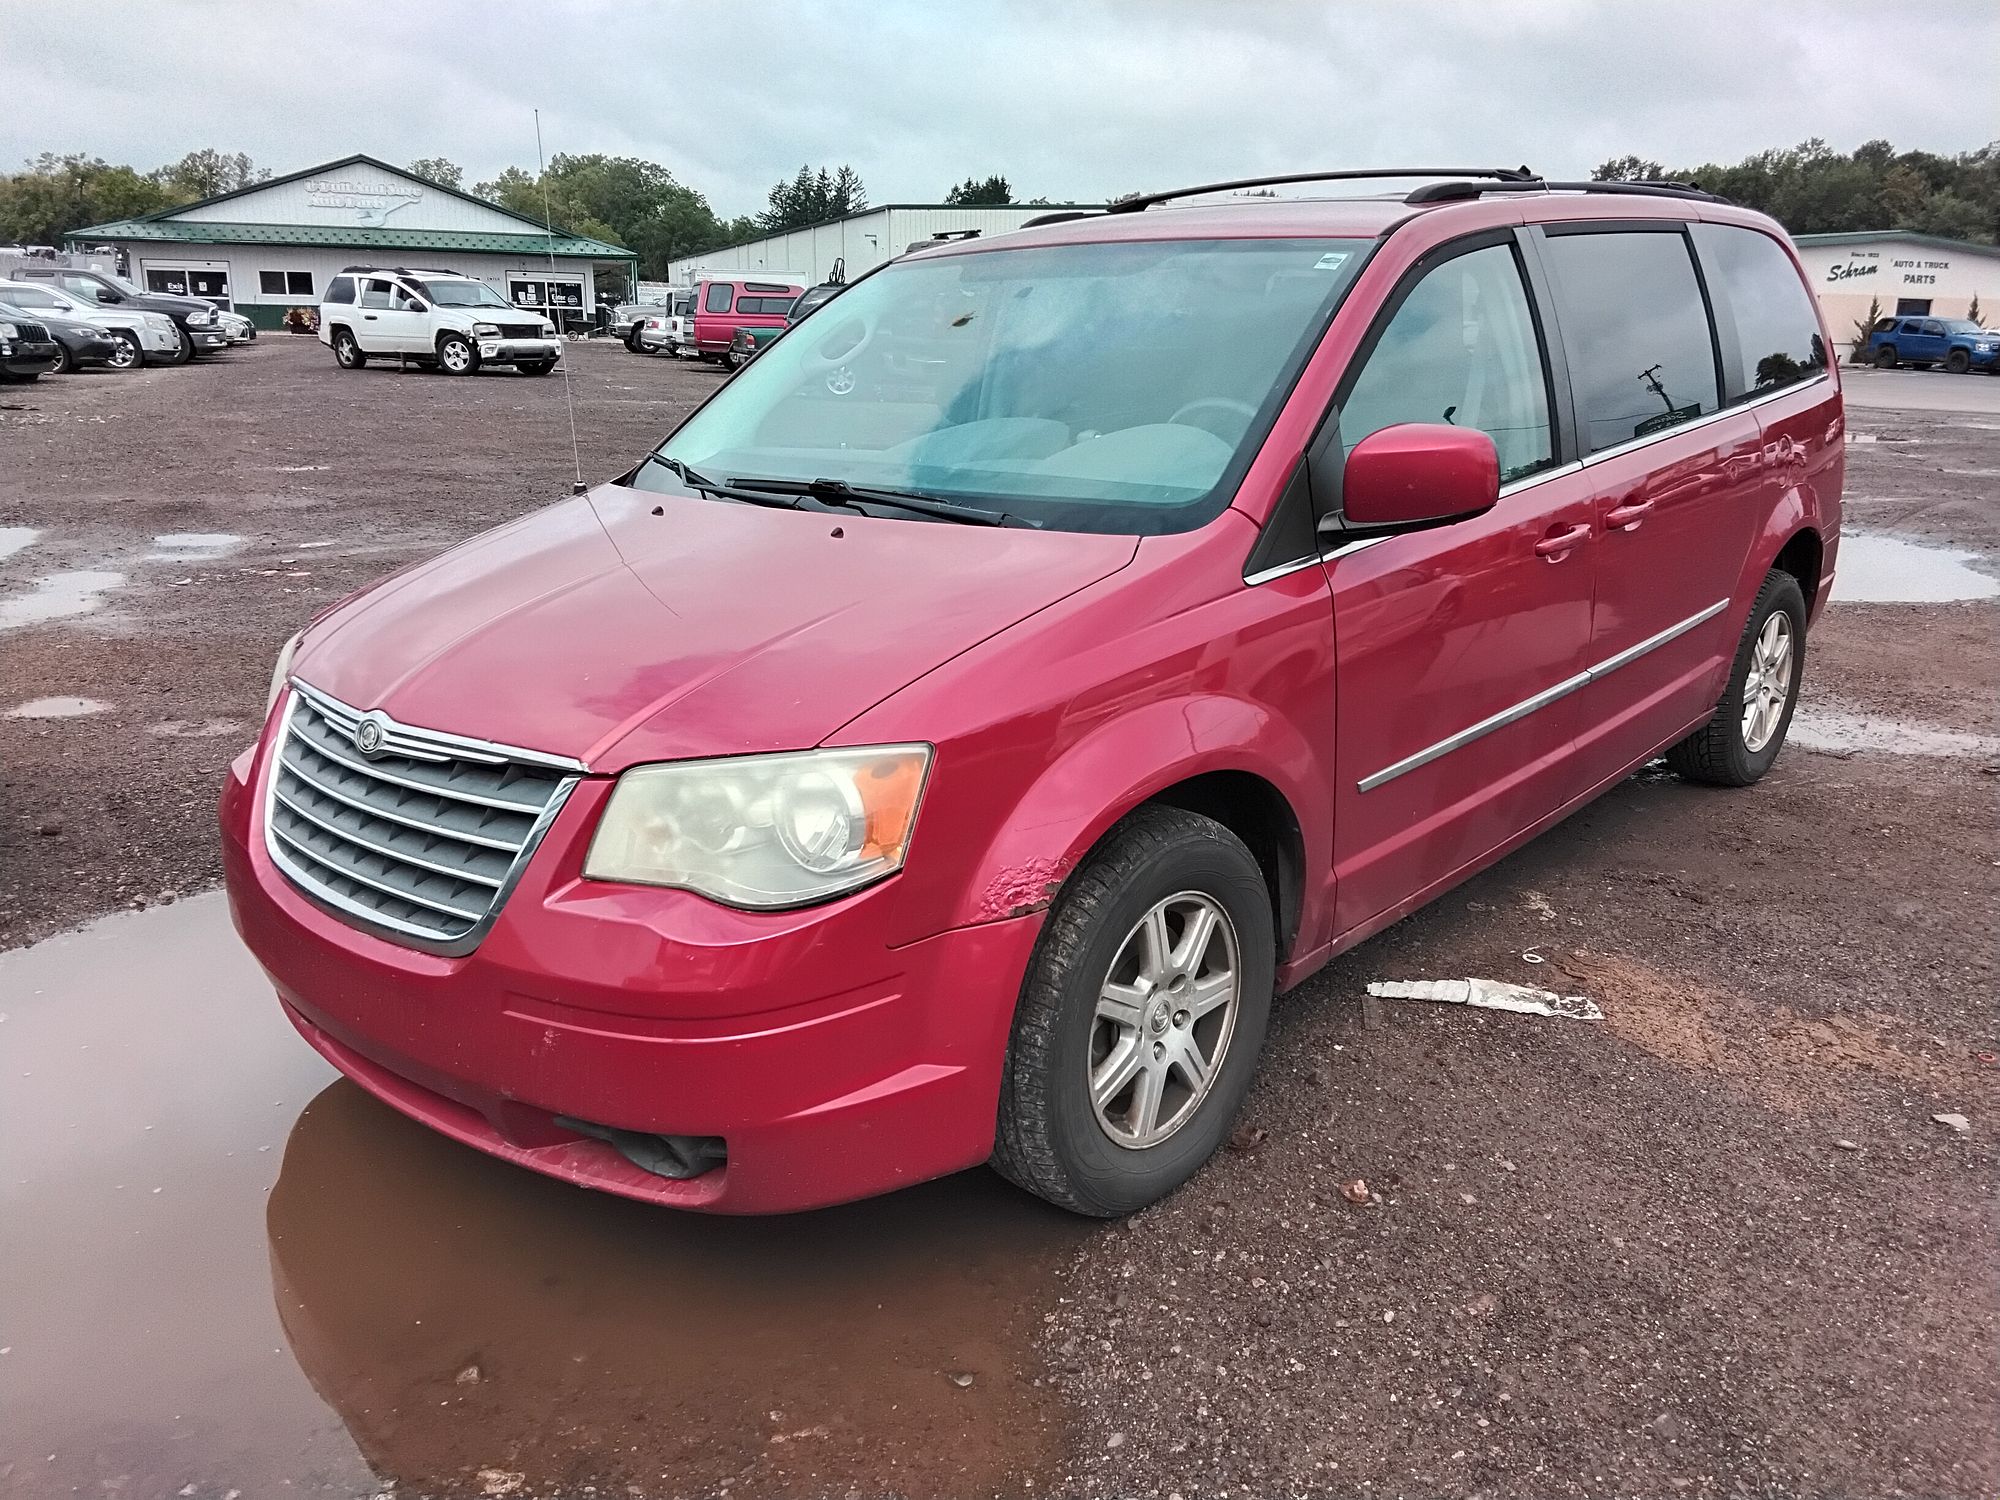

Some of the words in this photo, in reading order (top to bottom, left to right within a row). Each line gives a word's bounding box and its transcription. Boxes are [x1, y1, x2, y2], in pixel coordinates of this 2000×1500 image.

[1893, 260, 1914, 268] AUTO
[1924, 261, 1950, 269] TRUCK
[1827, 261, 1879, 282] Schram
[1903, 274, 1936, 284] PARTS
[167, 282, 184, 290] Exit
